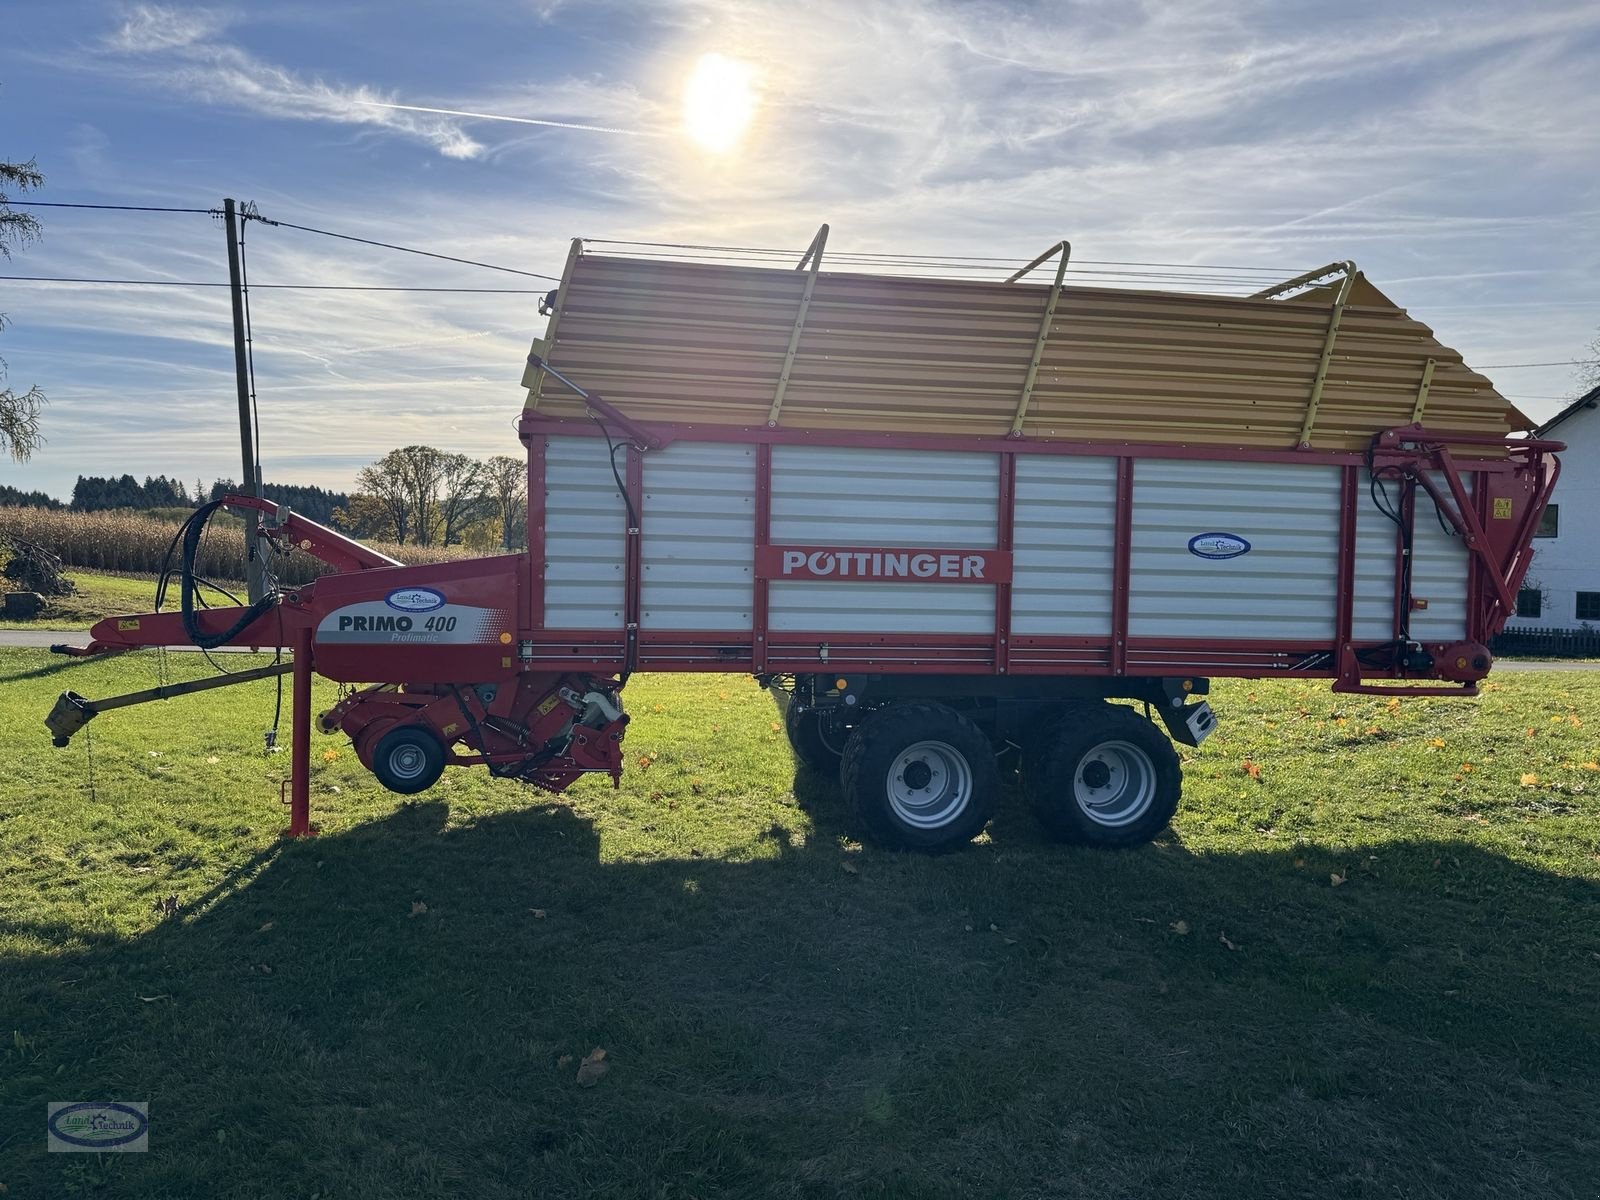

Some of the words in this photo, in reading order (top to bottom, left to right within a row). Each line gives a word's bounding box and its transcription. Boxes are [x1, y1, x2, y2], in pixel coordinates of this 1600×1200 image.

[415, 596, 438, 604] Technik
[339, 616, 413, 632] PRIMO
[424, 616, 457, 632] 400
[391, 633, 439, 642] Profimatic
